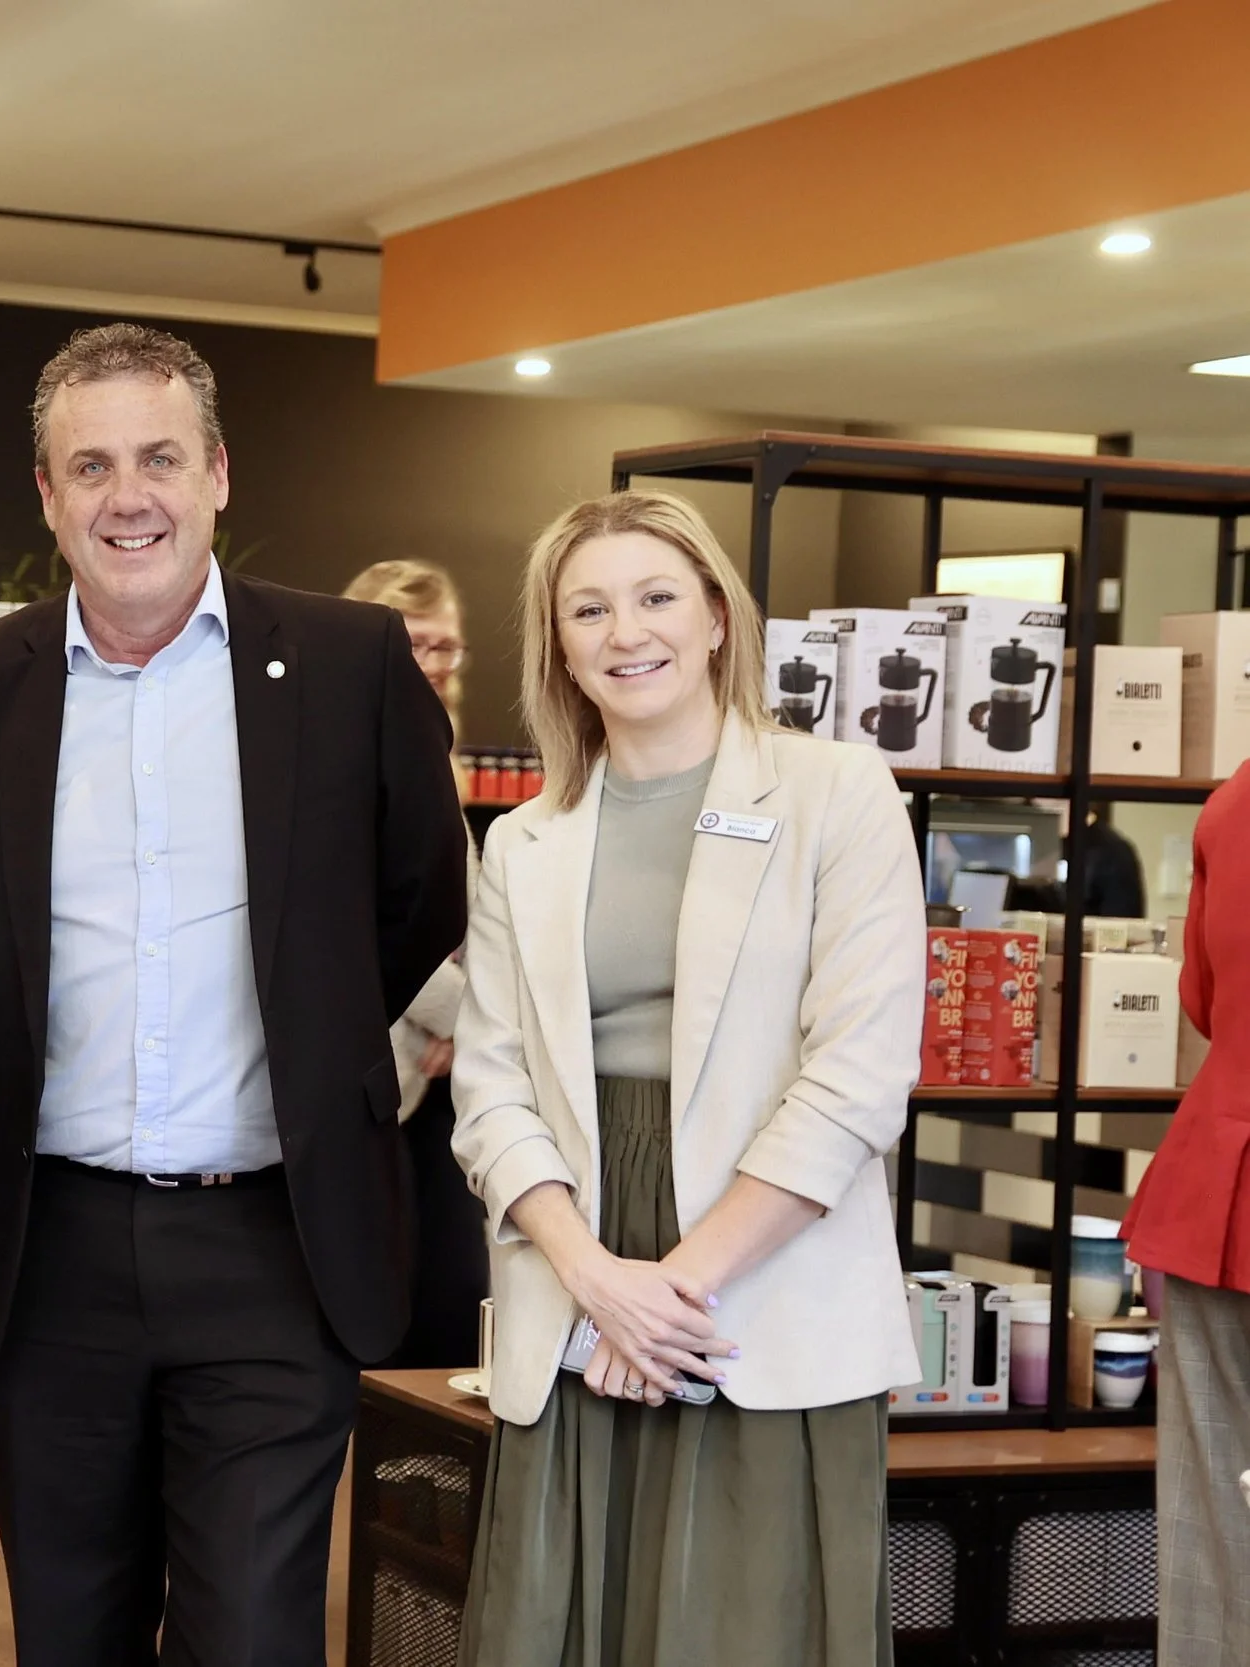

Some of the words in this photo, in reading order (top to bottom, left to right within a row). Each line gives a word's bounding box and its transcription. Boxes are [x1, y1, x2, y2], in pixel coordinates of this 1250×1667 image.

[908, 622, 942, 635] AVANTI
[1023, 612, 1062, 628] AVANTI
[805, 632, 835, 643] AVANTI
[1124, 682, 1162, 699] BIALETTI
[1121, 994, 1160, 1011] BIALETTI
[939, 1008, 962, 1026] BR
[1012, 1010, 1034, 1028] BR
